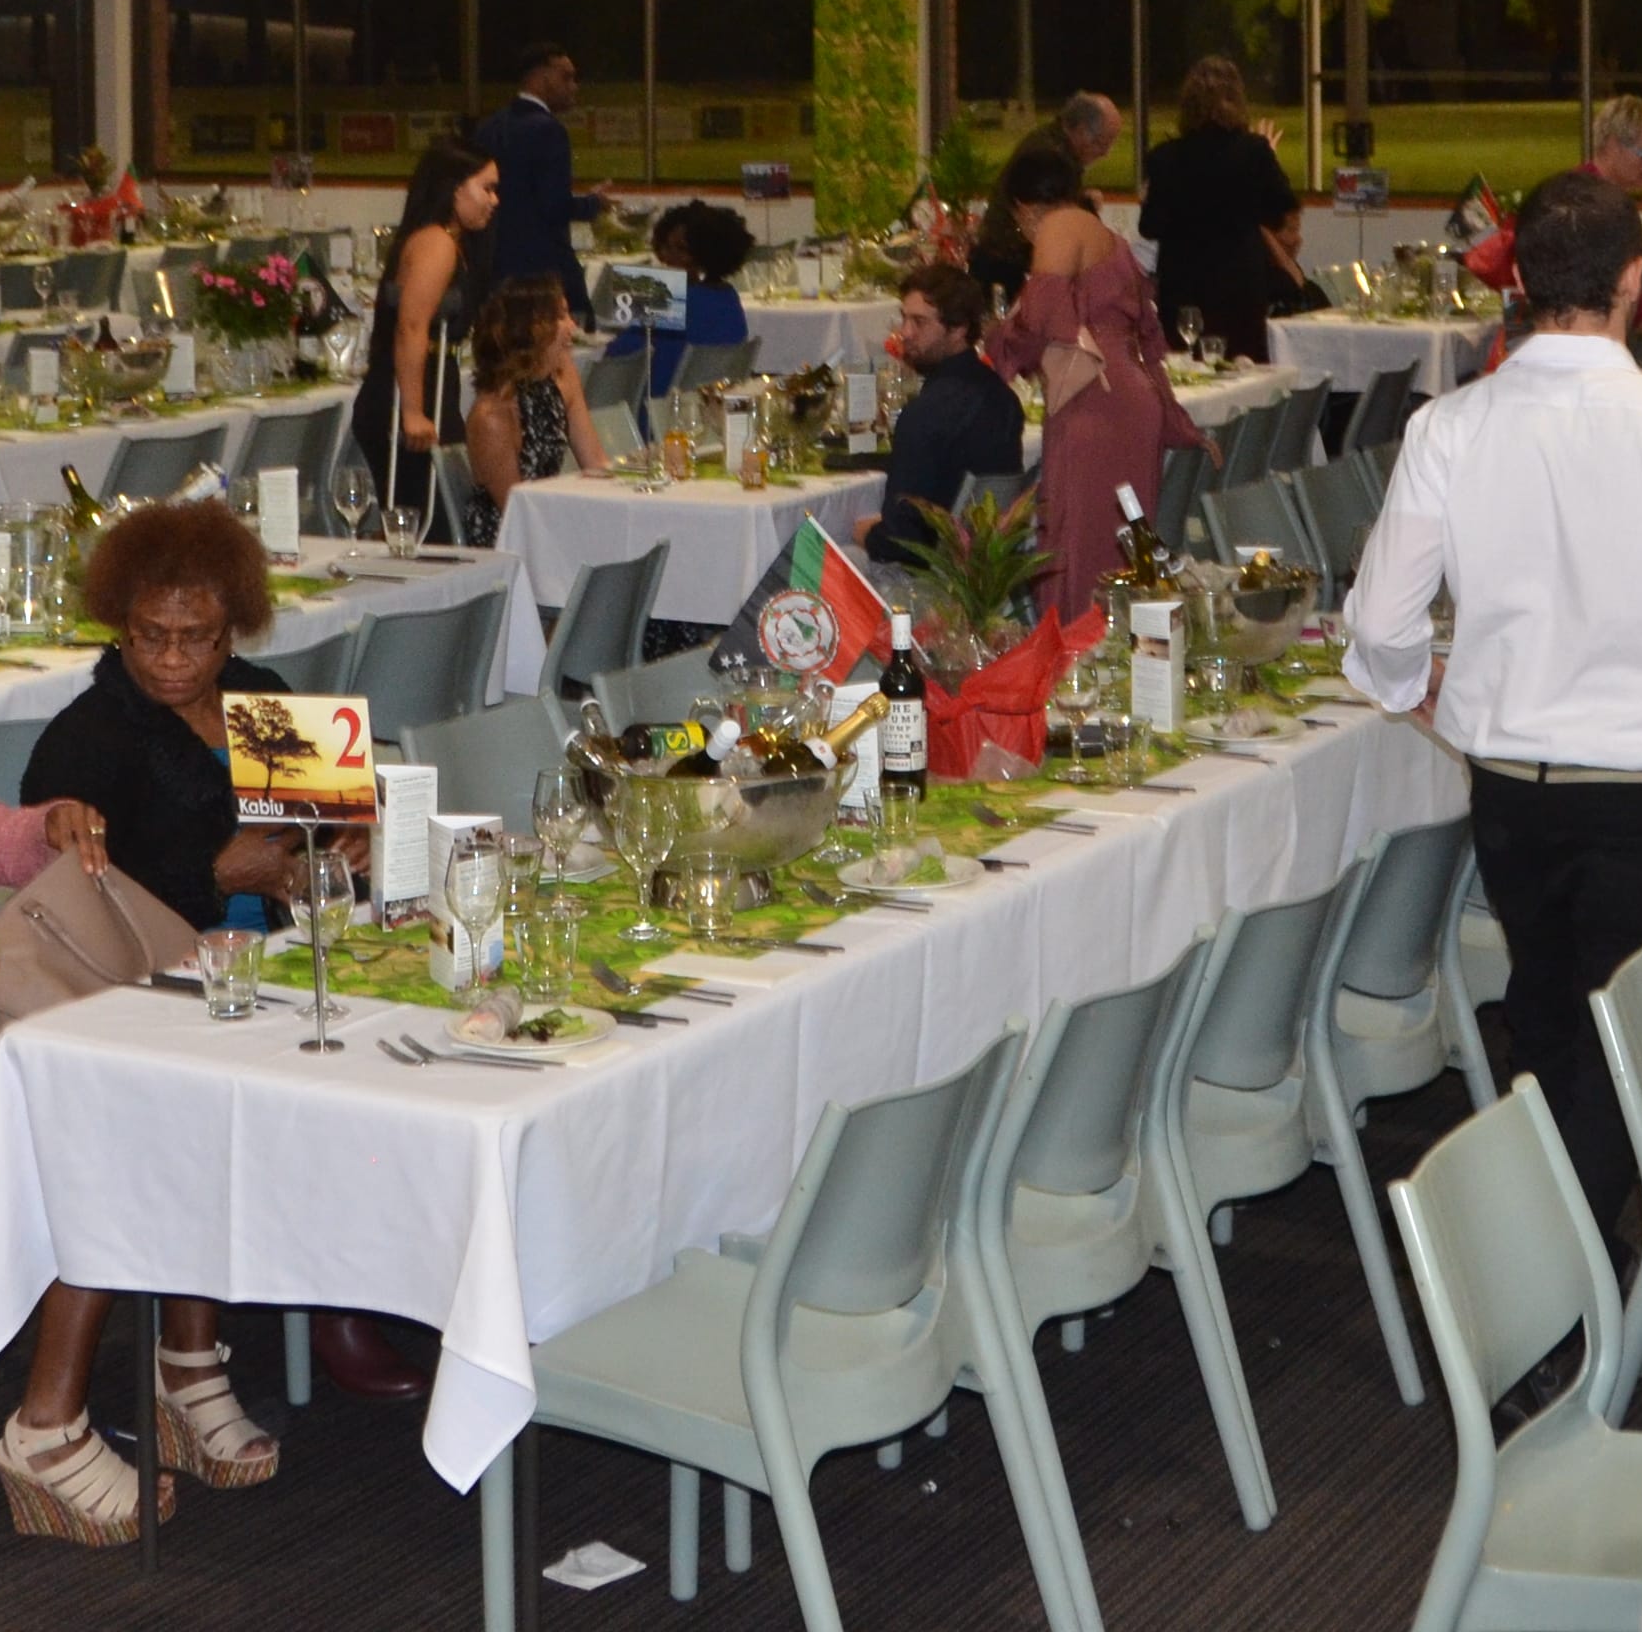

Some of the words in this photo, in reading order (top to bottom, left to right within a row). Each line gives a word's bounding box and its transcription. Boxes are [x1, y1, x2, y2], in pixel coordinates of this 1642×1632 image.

[615, 292, 633, 325] 8
[332, 706, 366, 769] 2
[238, 797, 285, 817] Kabiu
